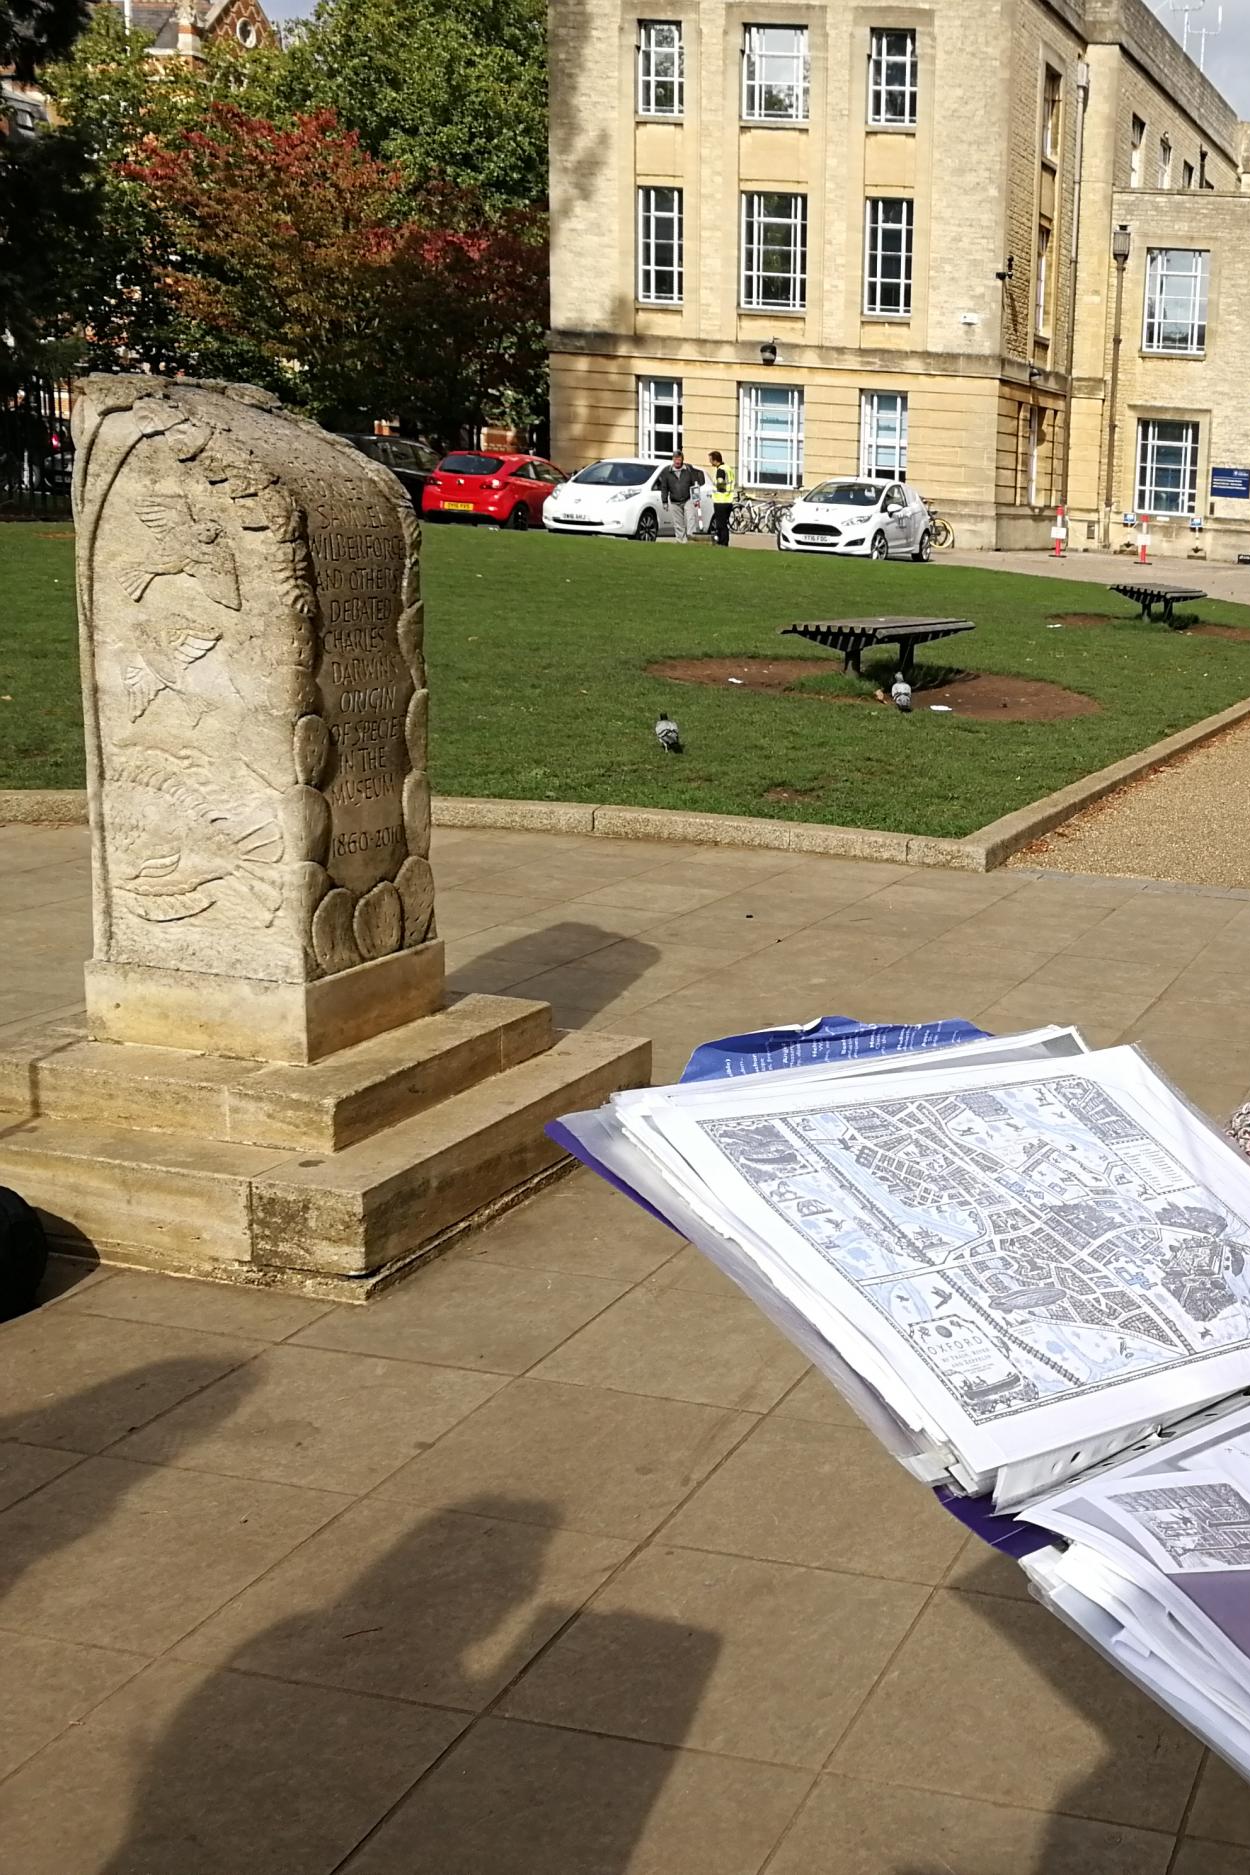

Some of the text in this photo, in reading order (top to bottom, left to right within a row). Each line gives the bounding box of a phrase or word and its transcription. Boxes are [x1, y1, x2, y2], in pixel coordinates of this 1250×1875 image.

[316, 504, 388, 530] SAMUEL
[309, 532, 405, 562] WILBERFORCE
[317, 567, 400, 594] AND OTHERS
[330, 596, 392, 623] DEBATED
[322, 626, 386, 655] CHARLES
[340, 686, 398, 714] ORIGIN
[329, 721, 351, 747] OF
[339, 746, 386, 775] IN THE
[331, 773, 396, 807] MUSEUM
[927, 1334, 984, 1356] OXFORD
